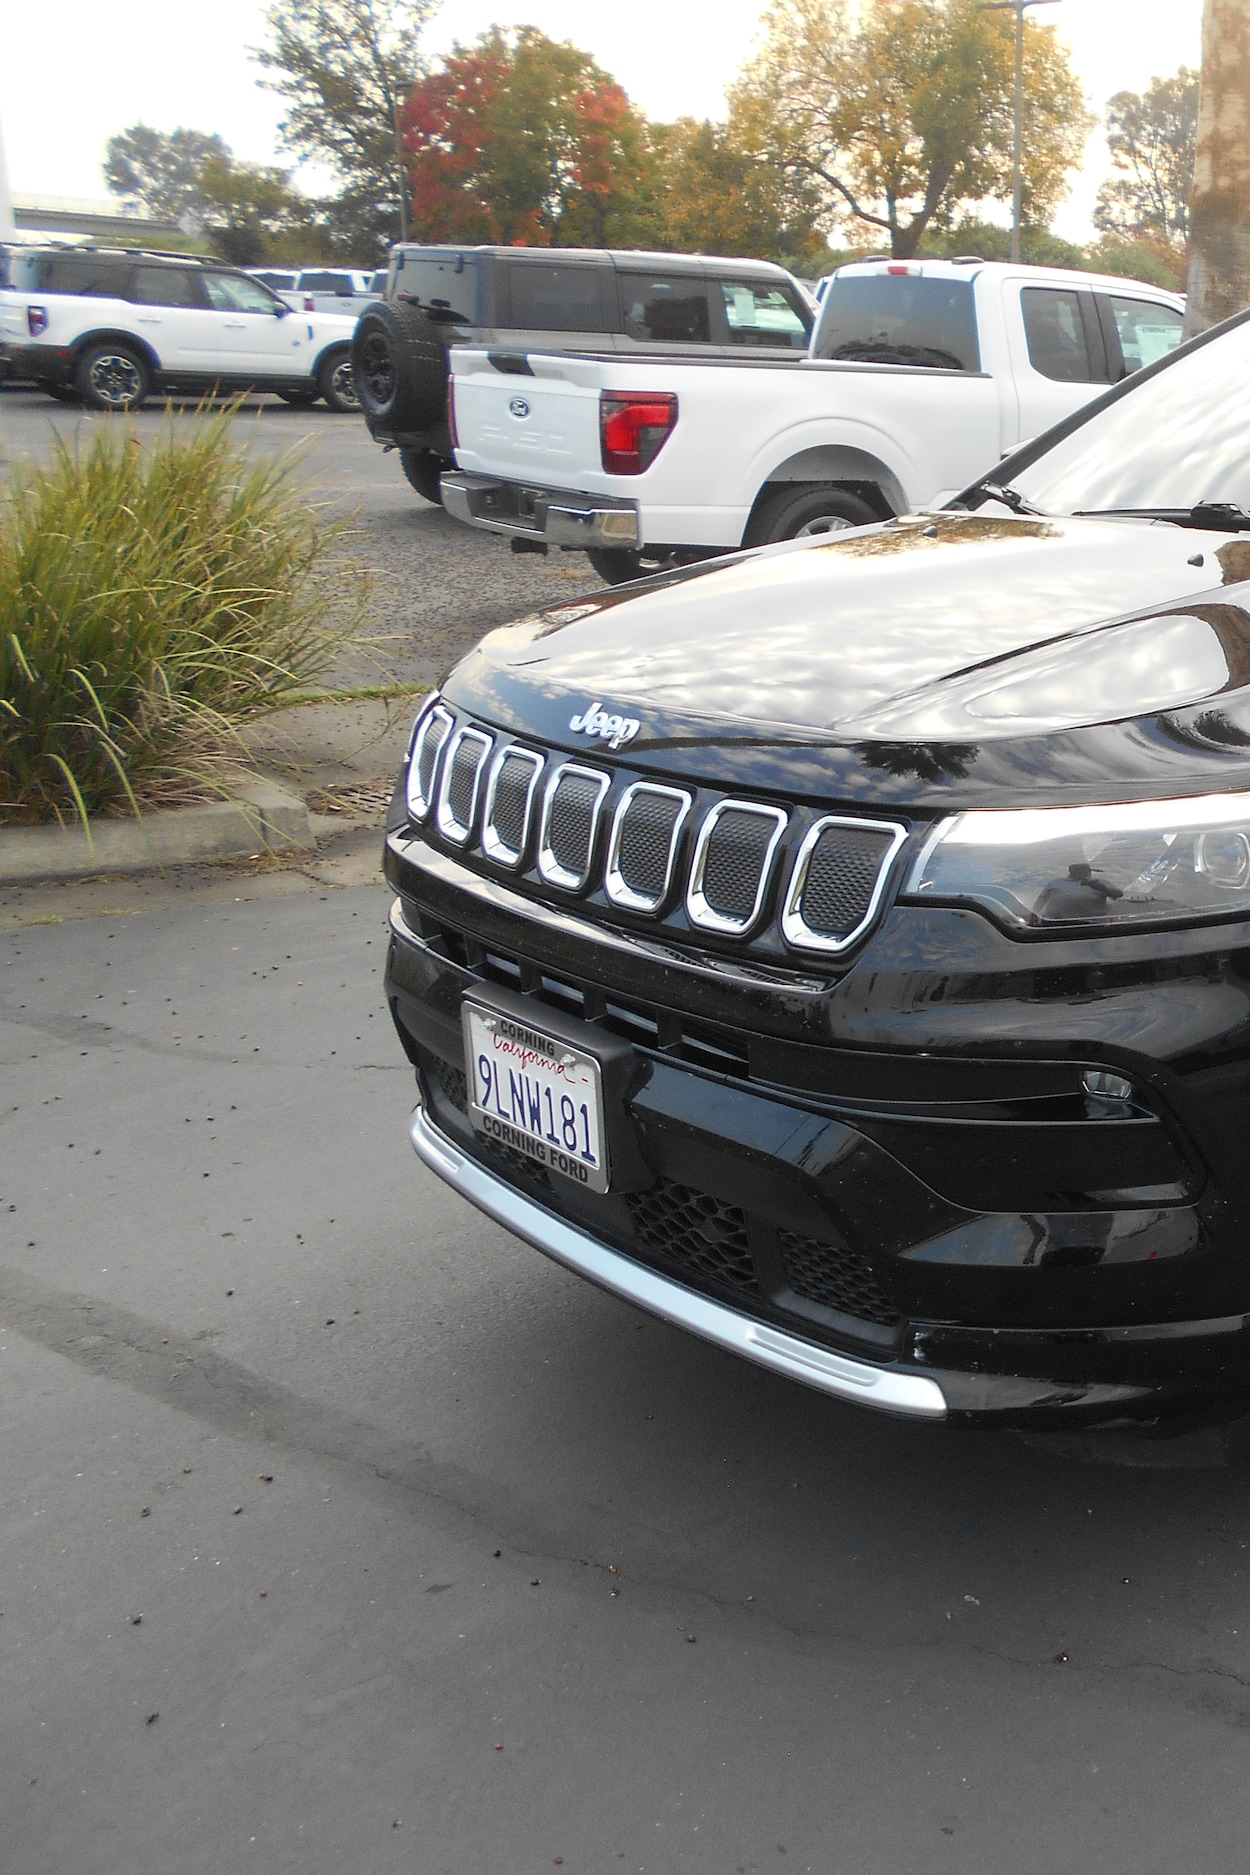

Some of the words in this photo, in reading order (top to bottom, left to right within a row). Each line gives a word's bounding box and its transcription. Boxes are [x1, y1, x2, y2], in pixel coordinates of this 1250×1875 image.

[569, 702, 640, 749] Jeep
[500, 1019, 555, 1056] CORNING
[478, 1054, 596, 1163] 9LNW181
[483, 1115, 545, 1162] CORNING
[549, 1148, 588, 1183] FORD
